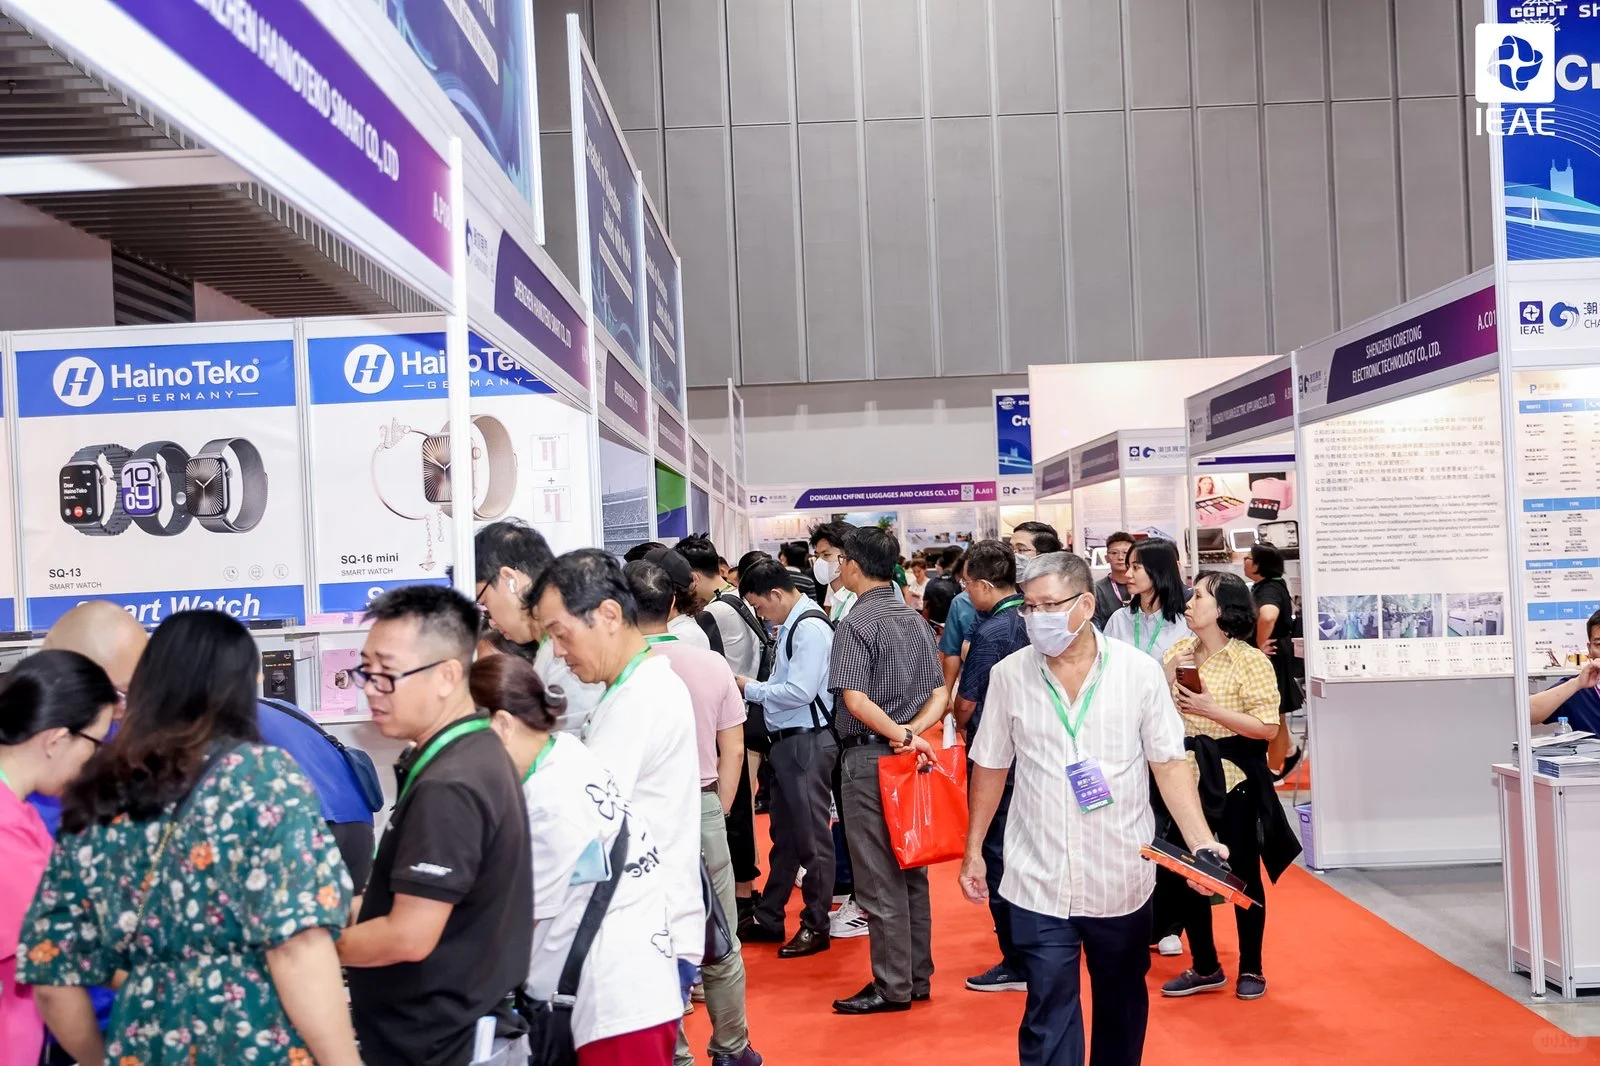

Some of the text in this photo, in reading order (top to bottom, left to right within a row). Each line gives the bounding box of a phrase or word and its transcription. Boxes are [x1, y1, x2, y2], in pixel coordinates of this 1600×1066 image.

[1510, 6, 1568, 18] CCPIT
[330, 87, 366, 151] SMART
[1477, 309, 1496, 331] A.C01
[1520, 325, 1544, 335] IEAE
[1366, 324, 1422, 359] SHENZHEN CORETONG
[1352, 363, 1382, 384] ELECTRONIC
[1381, 348, 1417, 376] TECHNOLOGY
[427, 377, 522, 390] GEMANY
[137, 391, 234, 403] GERMANY
[809, 494, 842, 502] DONGUAN
[842, 492, 865, 501] CHFINE
[866, 491, 899, 500] LUGGAGES
[900, 490, 915, 498] AND
[915, 490, 934, 498] CASES
[340, 552, 399, 565] SQ-16 mini
[49, 568, 82, 578] SQ-13
[341, 567, 394, 576] SMART WATCH
[49, 581, 102, 591] SMART WATCH
